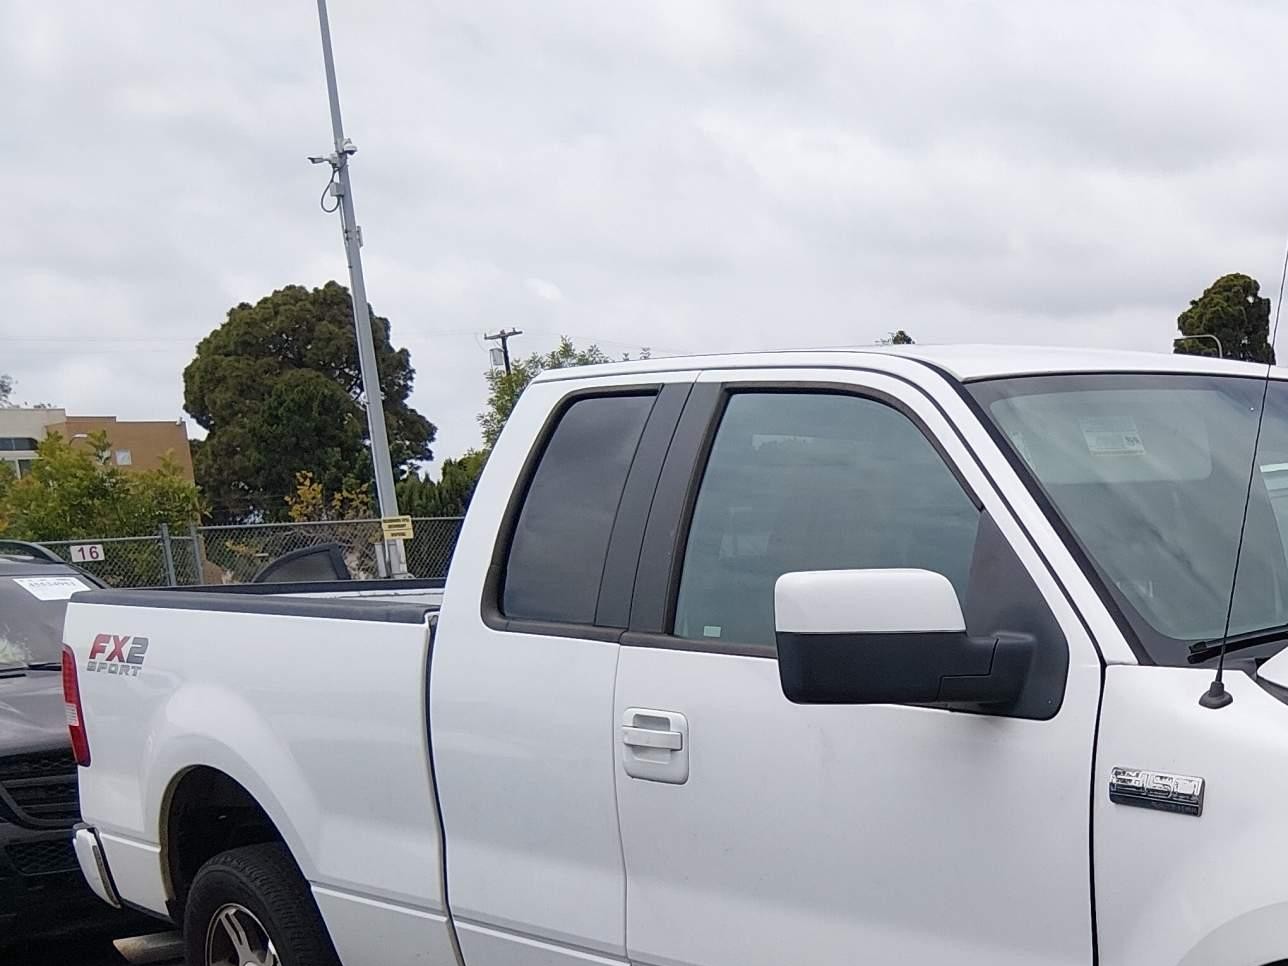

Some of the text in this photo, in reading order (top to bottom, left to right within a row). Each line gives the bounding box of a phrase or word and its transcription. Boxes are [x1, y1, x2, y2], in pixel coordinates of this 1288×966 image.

[77, 545, 100, 561] 16
[88, 633, 149, 665] FX2
[86, 661, 142, 677] SPORT
